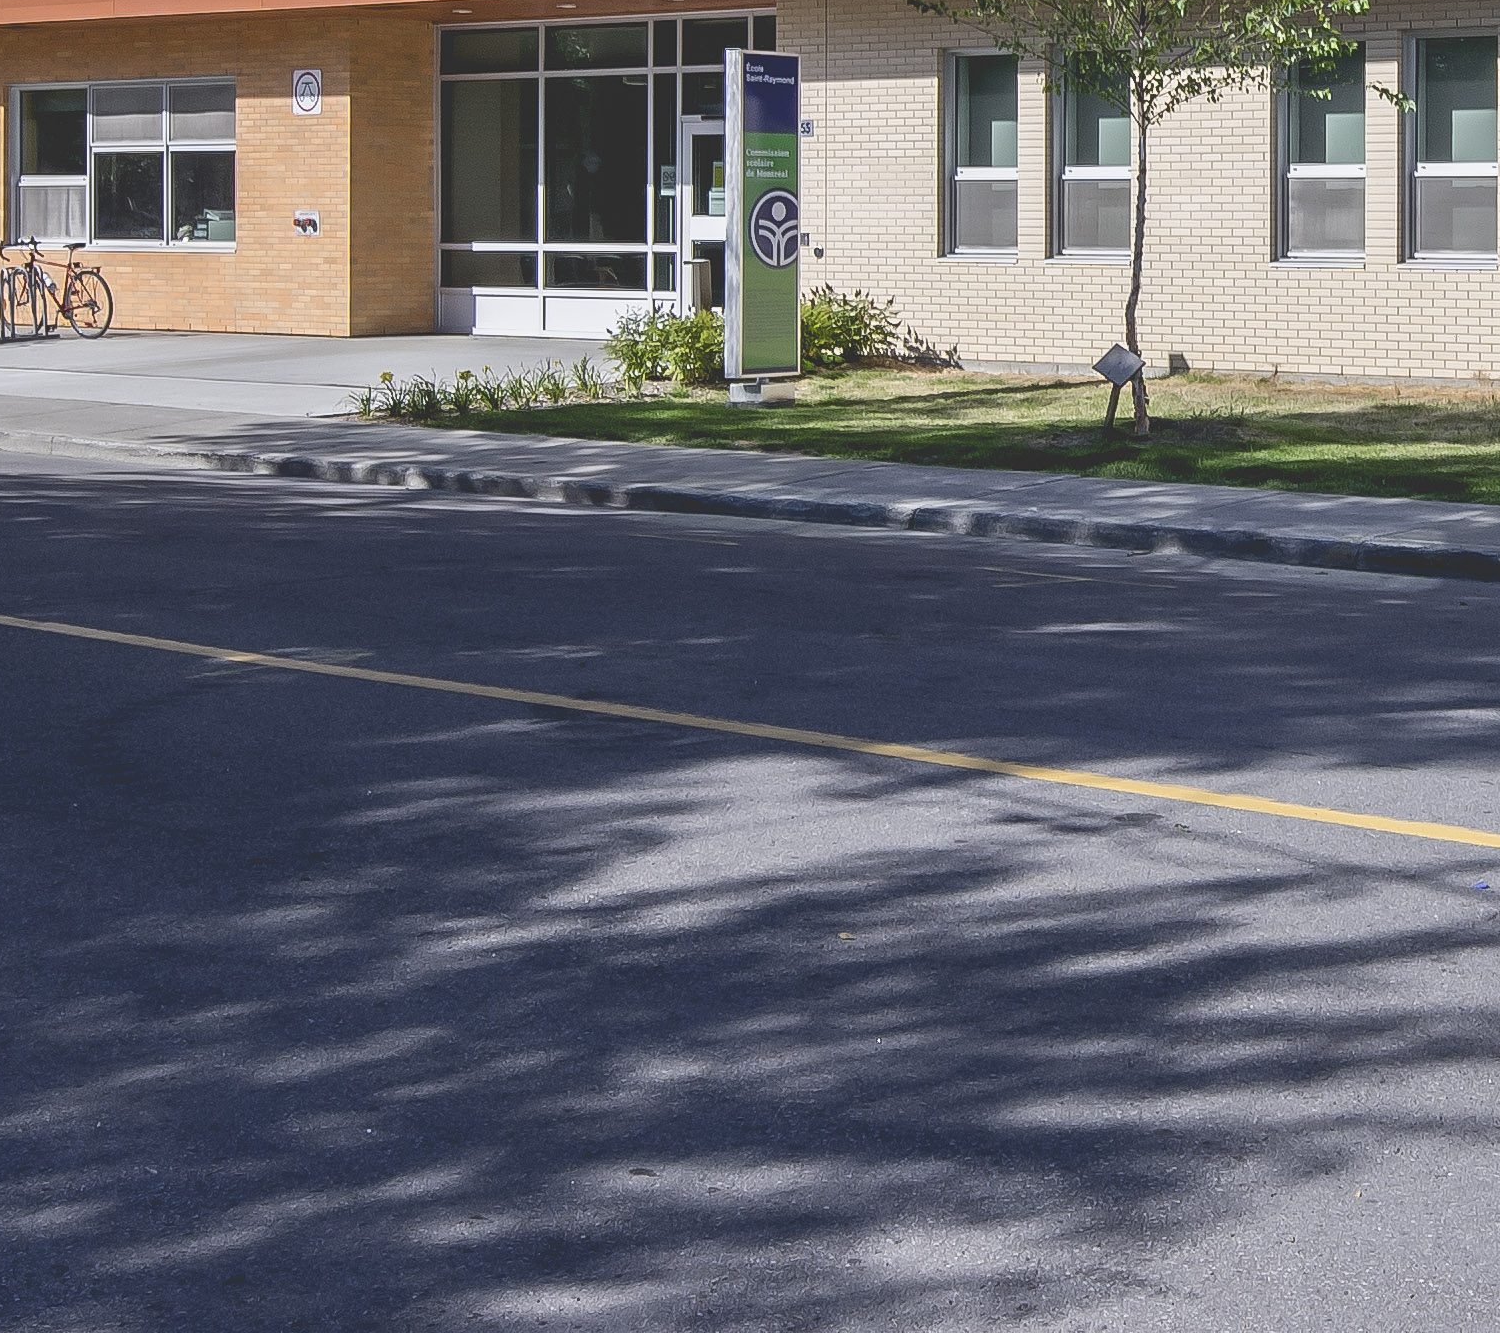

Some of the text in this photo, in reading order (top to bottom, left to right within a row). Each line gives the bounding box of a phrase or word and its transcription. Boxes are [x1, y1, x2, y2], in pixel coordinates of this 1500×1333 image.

[746, 62, 764, 73] École
[746, 74, 795, 85] Saint-Raymond
[746, 149, 789, 158] Commission
[746, 160, 774, 168] scolaire
[746, 169, 788, 178] de Montréal
